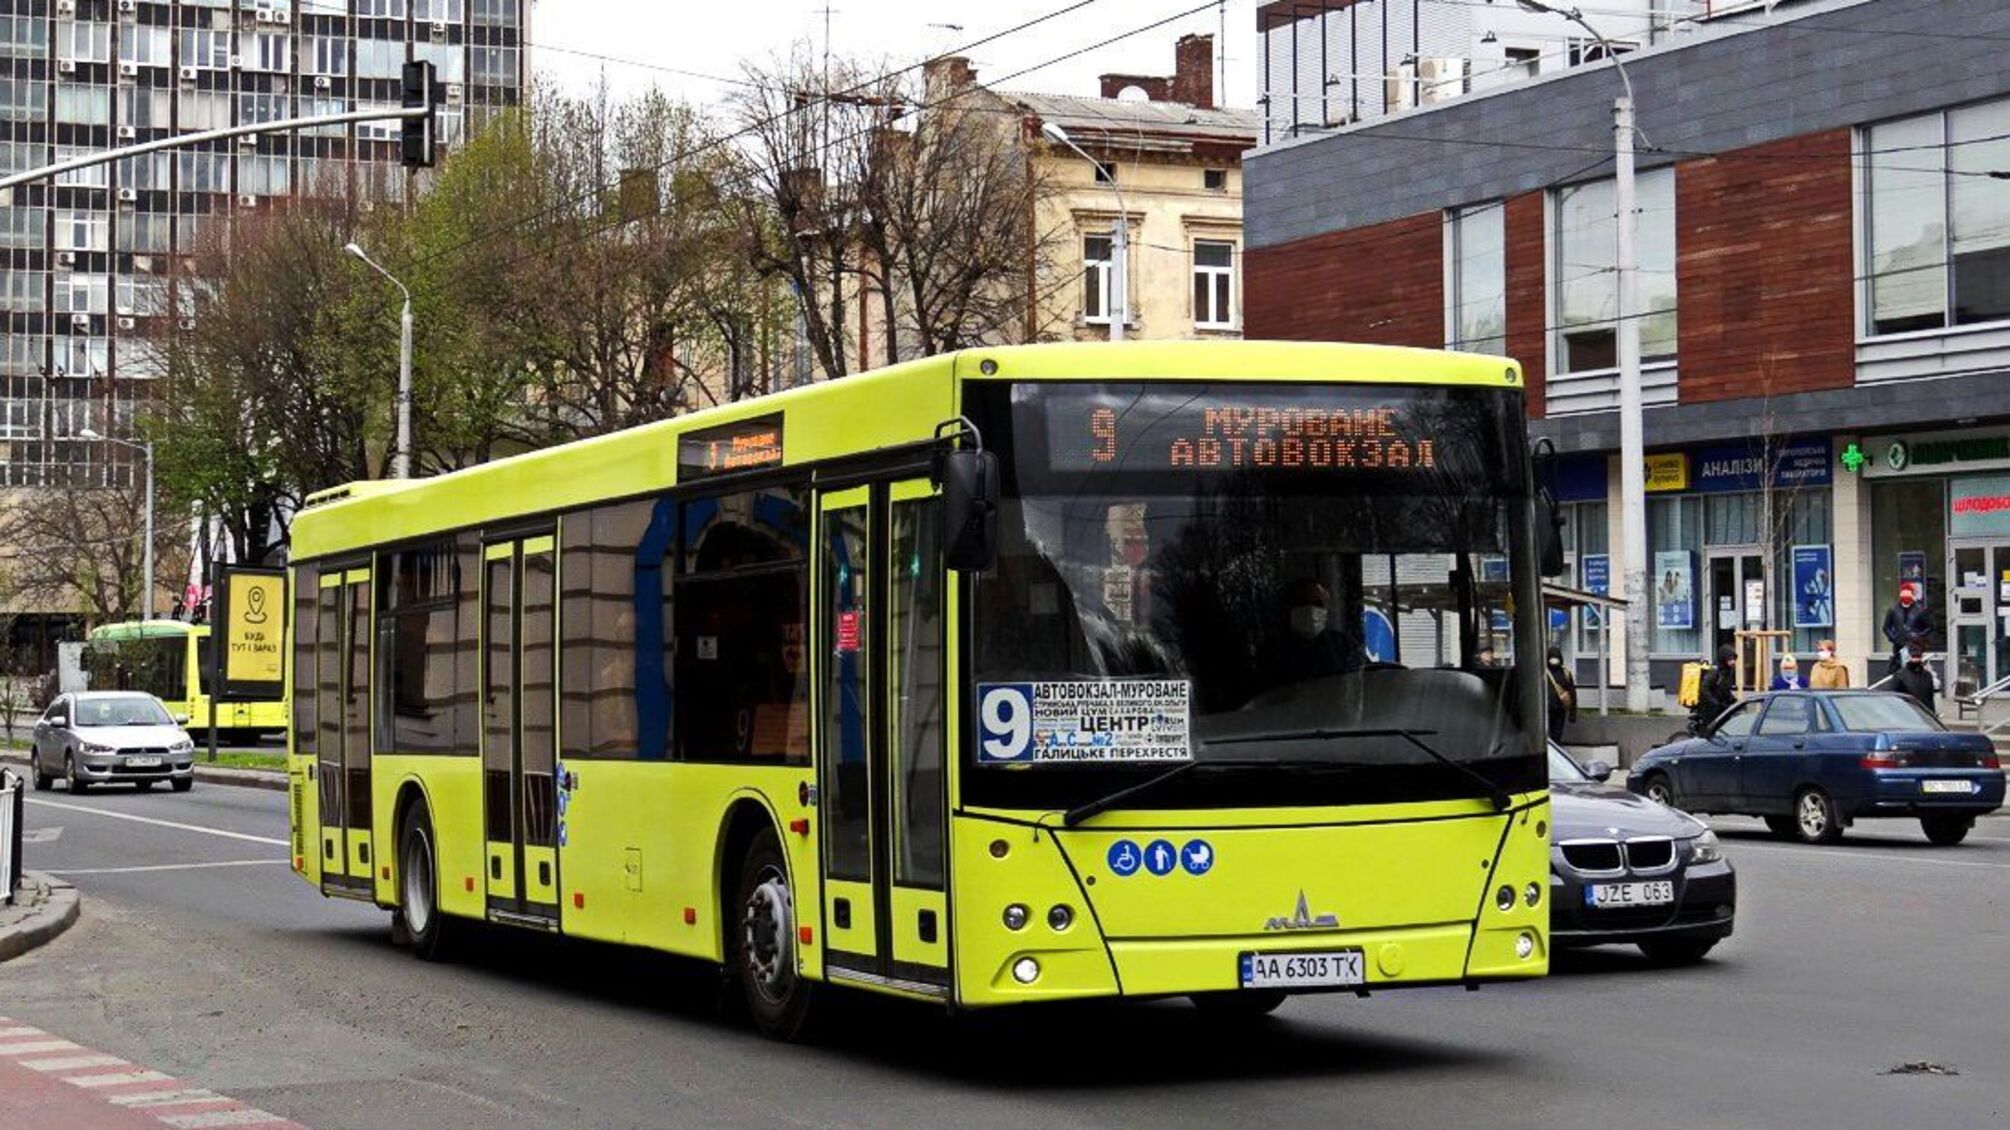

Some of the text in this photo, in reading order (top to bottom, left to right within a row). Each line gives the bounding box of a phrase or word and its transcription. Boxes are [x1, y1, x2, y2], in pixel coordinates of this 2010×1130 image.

[1093, 407, 1396, 462] 9 МУРОВАНЕ
[1171, 438, 1433, 467] АВТОВОКЗАЛ
[1702, 458, 1764, 477] АНАЛІЗИ
[1035, 682, 1186, 699] АВТОВОКЗАЛ-МУРОВАНЕ
[1035, 708, 1078, 717] НОВИЙ
[1082, 708, 1108, 718] ЦУМ
[981, 687, 1031, 759] 9
[1080, 716, 1149, 734] ЦЕНТР
[1035, 747, 1188, 760] ГАЛИЦЬКЕ ПЕРЕХРЕСТЯ
[1597, 882, 1670, 902] JZE 063
[1257, 959, 1281, 978] AA
[1286, 957, 1327, 977] 6303
